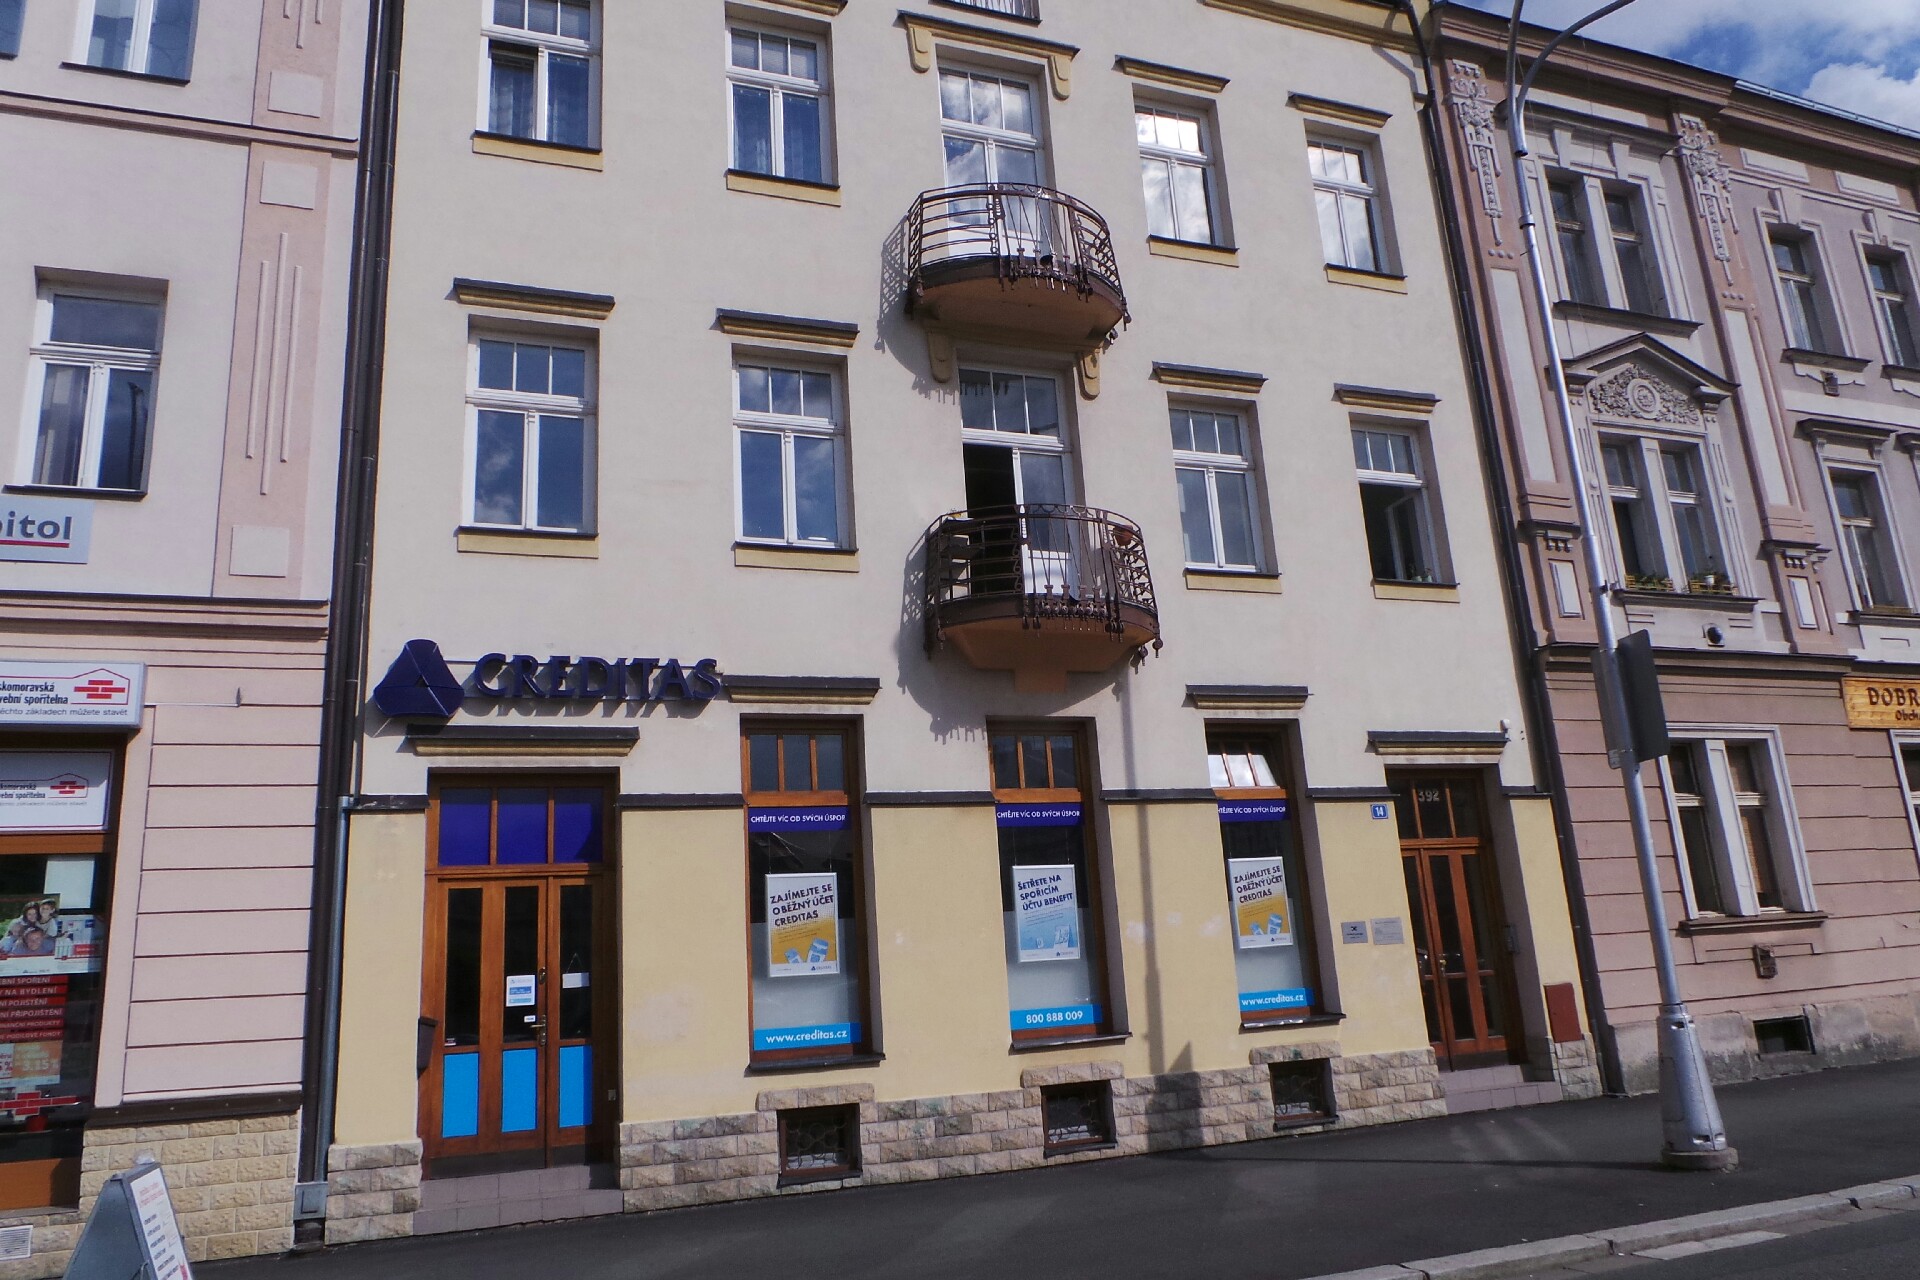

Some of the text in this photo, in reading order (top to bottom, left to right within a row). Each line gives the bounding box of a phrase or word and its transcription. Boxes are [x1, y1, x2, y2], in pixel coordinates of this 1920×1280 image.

[0, 511, 72, 540] itol
[474, 652, 722, 700] CREDITAS
[24, 693, 69, 706] spořitelna
[1866, 686, 1920, 707] DOBR
[25, 707, 67, 716] základech
[70, 708, 100, 716] můžete
[103, 708, 128, 716] stavět
[1418, 790, 1440, 802] 392
[750, 814, 776, 823] CHTĚJTE
[777, 814, 789, 823] VÍC
[802, 813, 823, 822] SVÝCH
[824, 813, 846, 821] ÚSPOR
[997, 810, 1019, 818] CHTĚJTE
[1020, 809, 1030, 818] VÍC
[1042, 809, 1061, 817] SVÝCH
[1061, 809, 1080, 817] ÚSPOR
[1374, 806, 1385, 817] 14
[1017, 874, 1062, 891] ŠETŘETE NA
[1233, 865, 1281, 884] ZAJÍMEJTE SE
[1236, 874, 1283, 894] OBĚŽNÝ ÚČET
[770, 883, 833, 904] ZAJÍMEJTE SE
[1020, 885, 1059, 901] SPOŘICÍM
[1239, 888, 1272, 904] CREDITAS
[772, 894, 834, 916] OBĚŽNÝ ÚČET
[1022, 892, 1073, 911] ÚČTU BENEFIT
[774, 909, 819, 927] CREDITAS
[20, 986, 57, 995] BYDLENÍ
[1241, 993, 1304, 1006] www.creditas.cz
[1025, 1010, 1083, 1024] 800 888 009
[766, 1029, 848, 1044] www.creditas.cz
